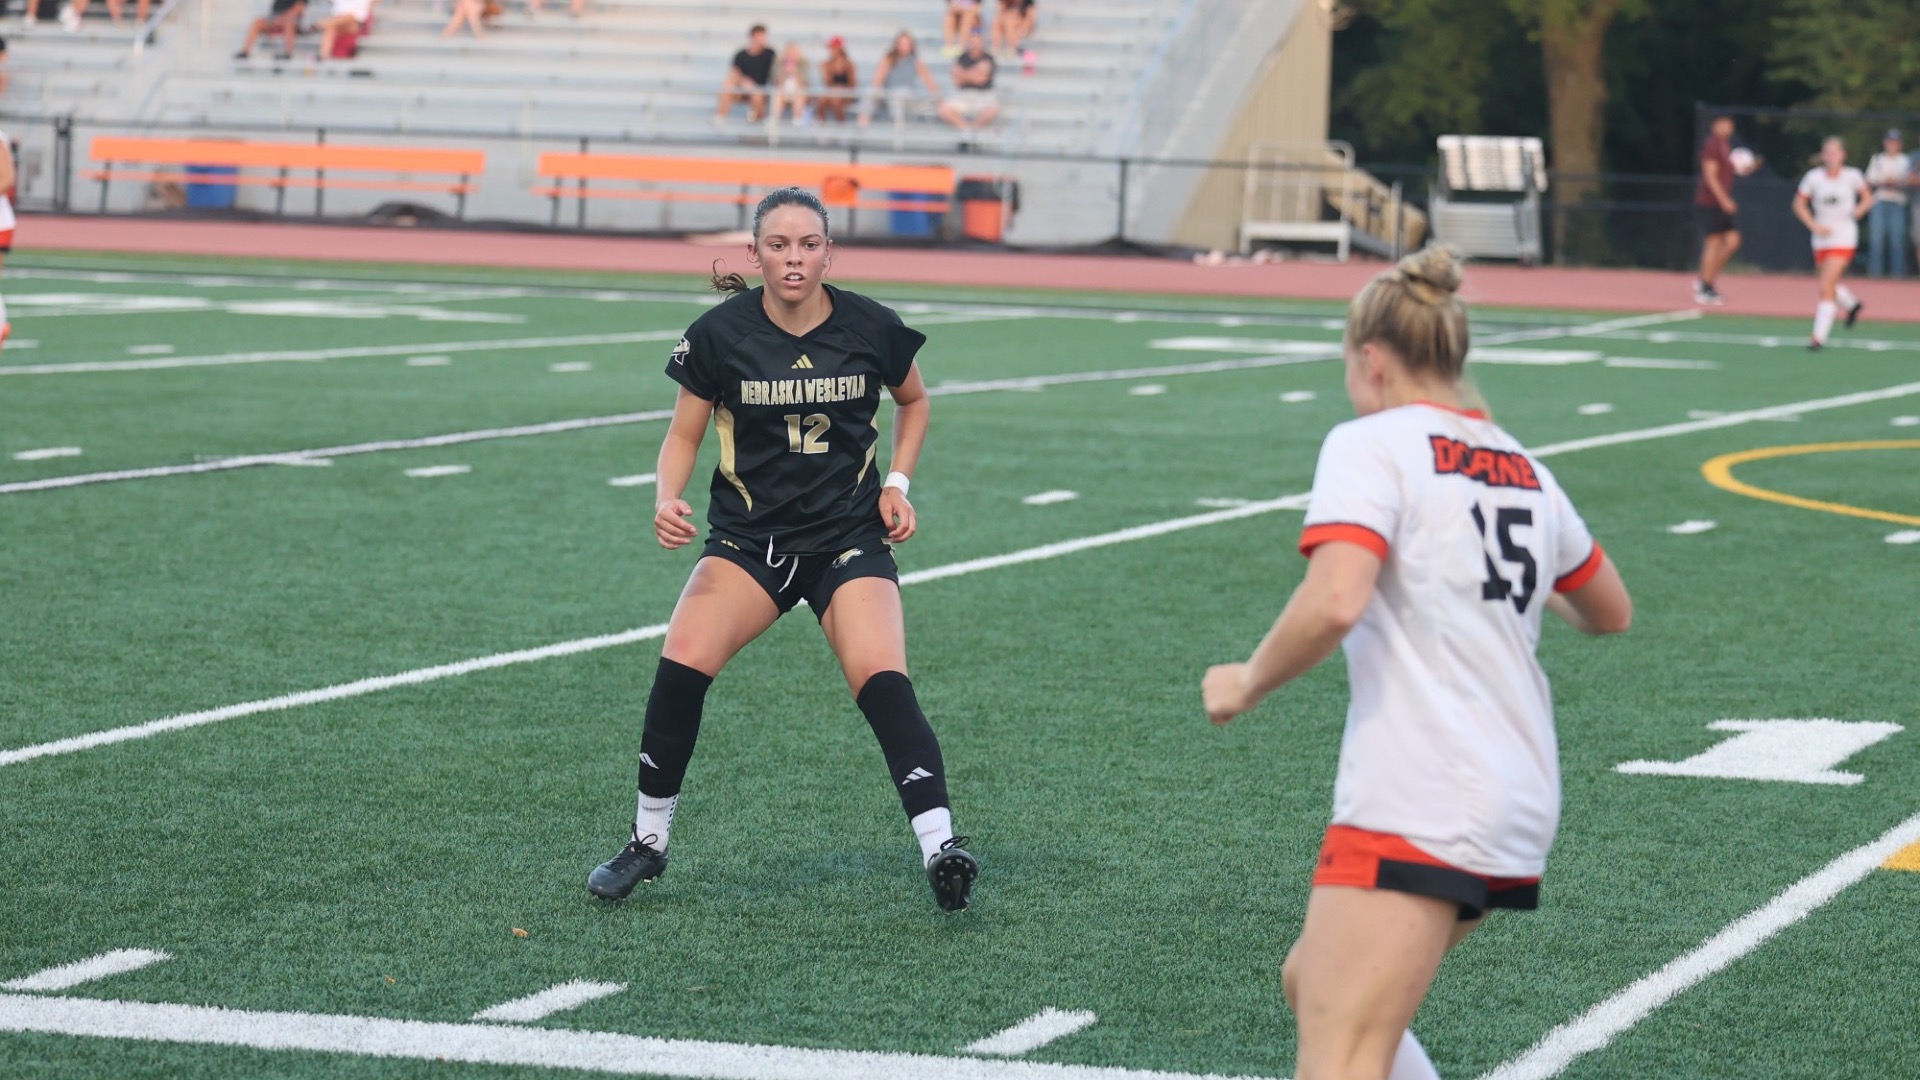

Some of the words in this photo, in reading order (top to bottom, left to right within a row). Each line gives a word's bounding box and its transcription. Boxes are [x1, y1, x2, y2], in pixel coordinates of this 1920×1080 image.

[741, 379, 804, 406] NEBRASKA
[804, 373, 866, 404] WESLEYAN
[783, 413, 831, 455] 12
[1470, 500, 1537, 615] 15
